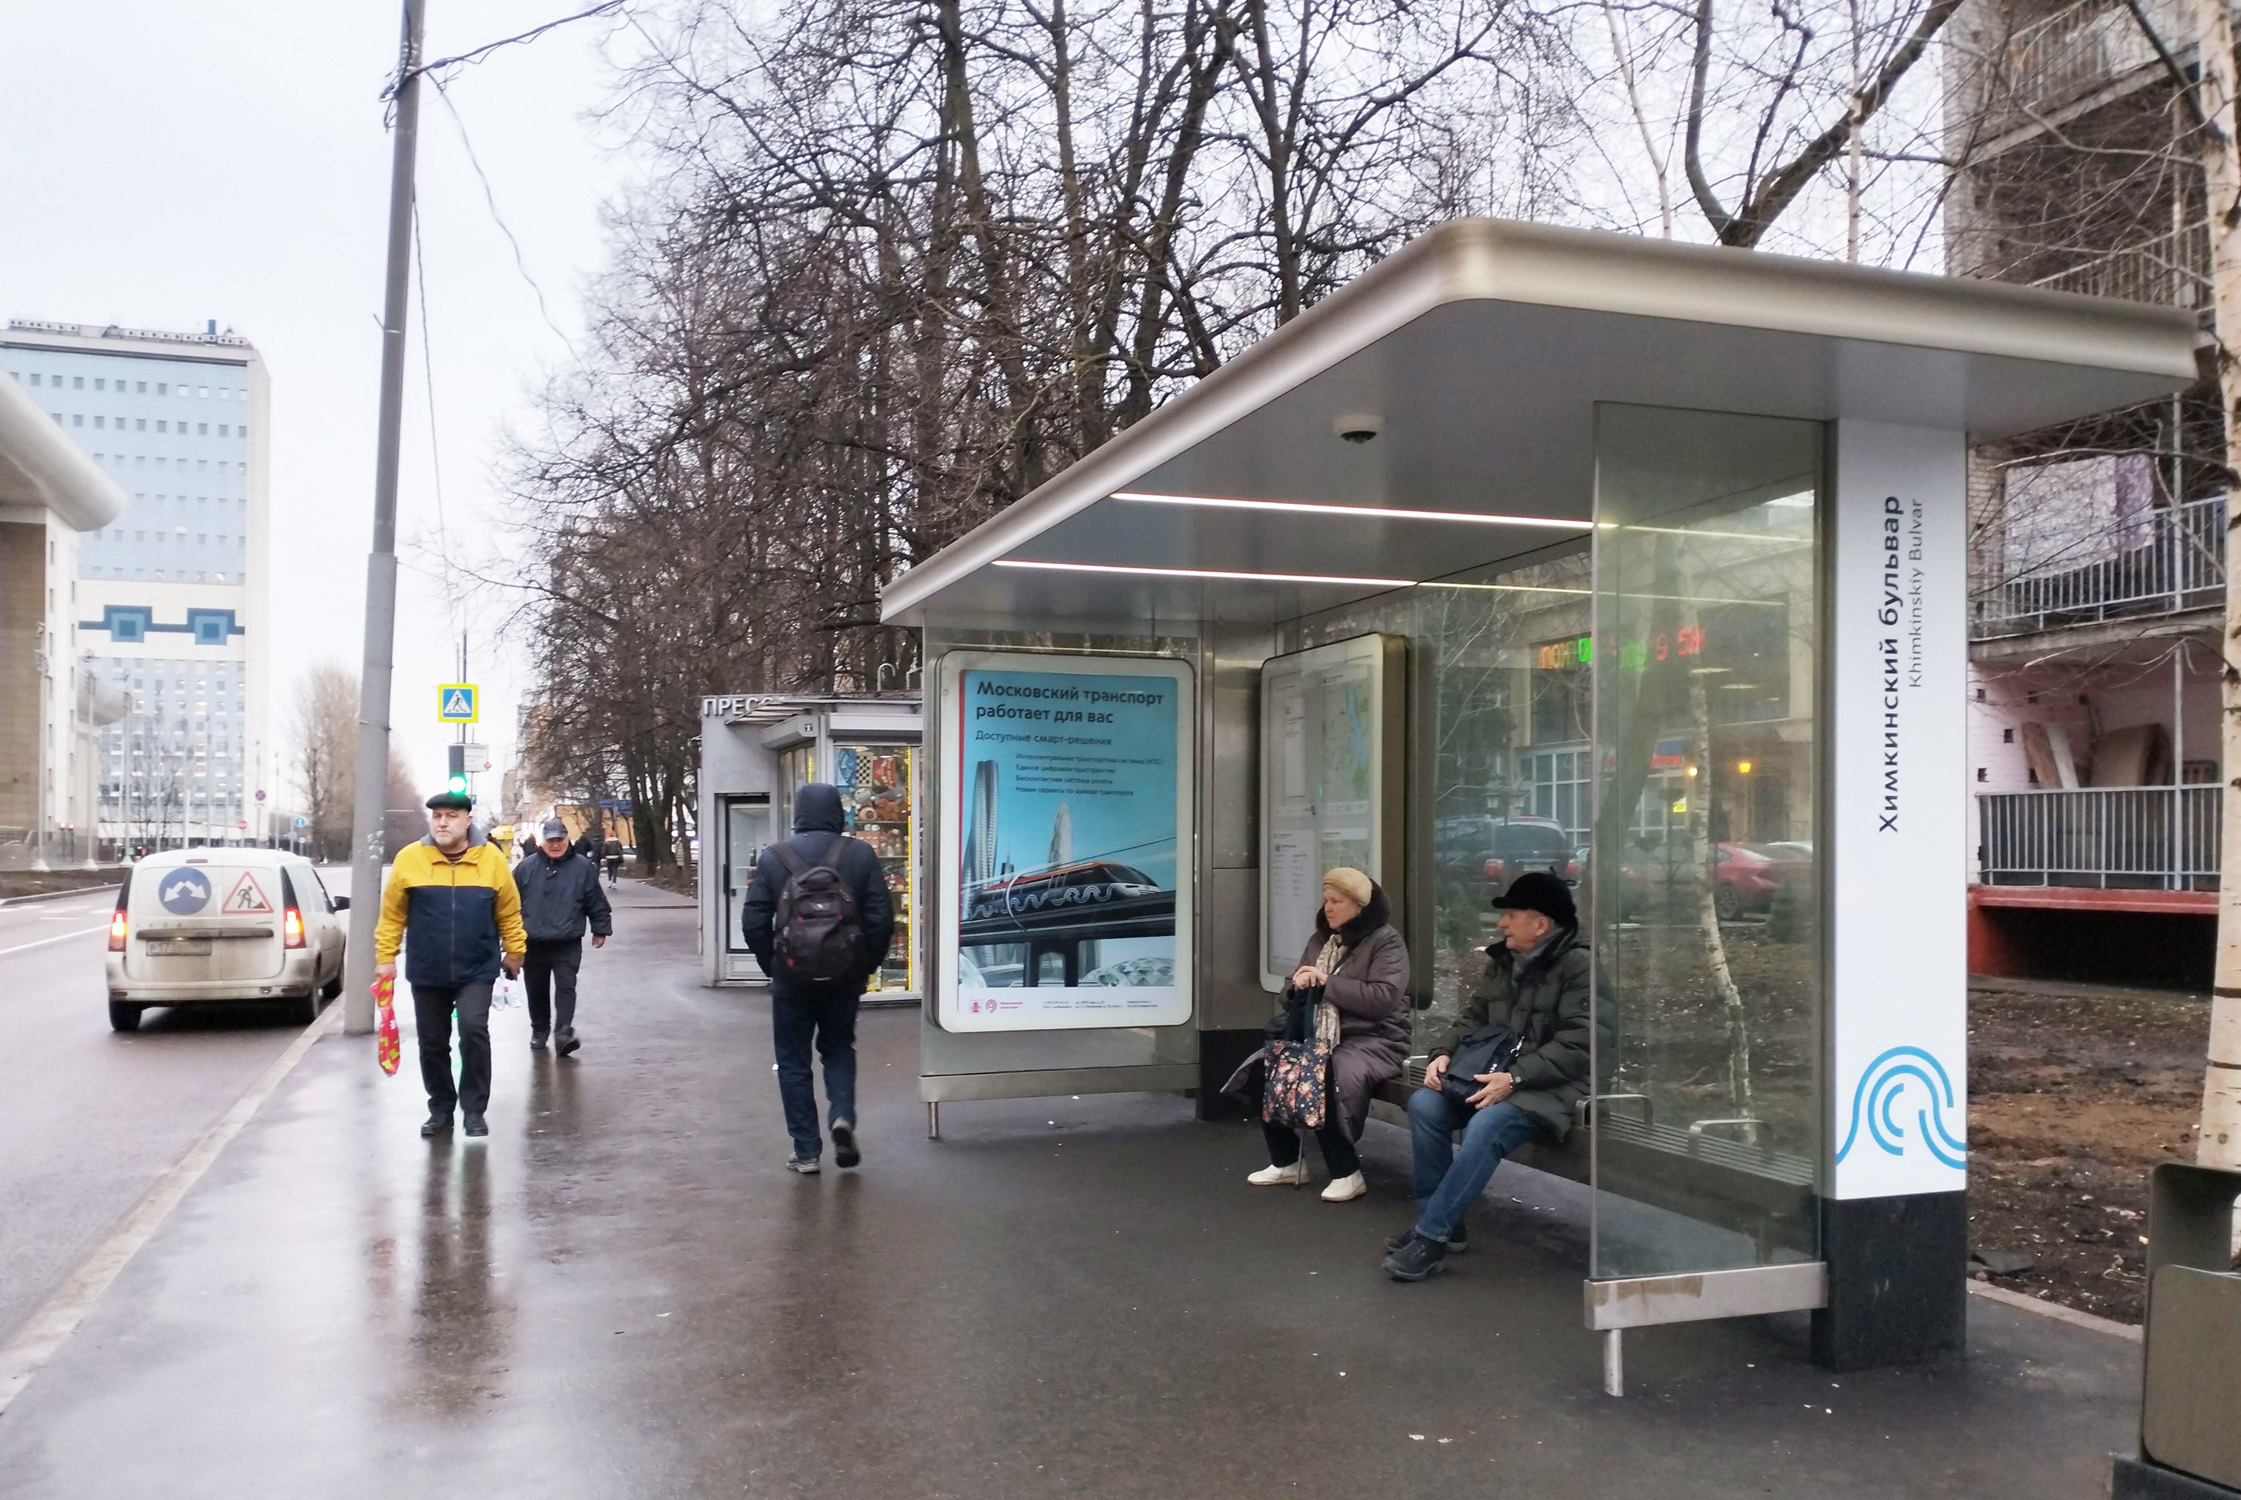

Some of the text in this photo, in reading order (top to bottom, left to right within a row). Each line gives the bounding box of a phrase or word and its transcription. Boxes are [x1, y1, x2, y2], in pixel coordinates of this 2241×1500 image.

[1907, 498, 1926, 689] Khimkinskiy Bulvar
[1877, 495, 1905, 833] Химкинский бульвар
[977, 681, 1164, 707] Московский транспорт
[976, 705, 1114, 724] работает для вас
[975, 730, 1111, 746] Доступные смарт-решения
